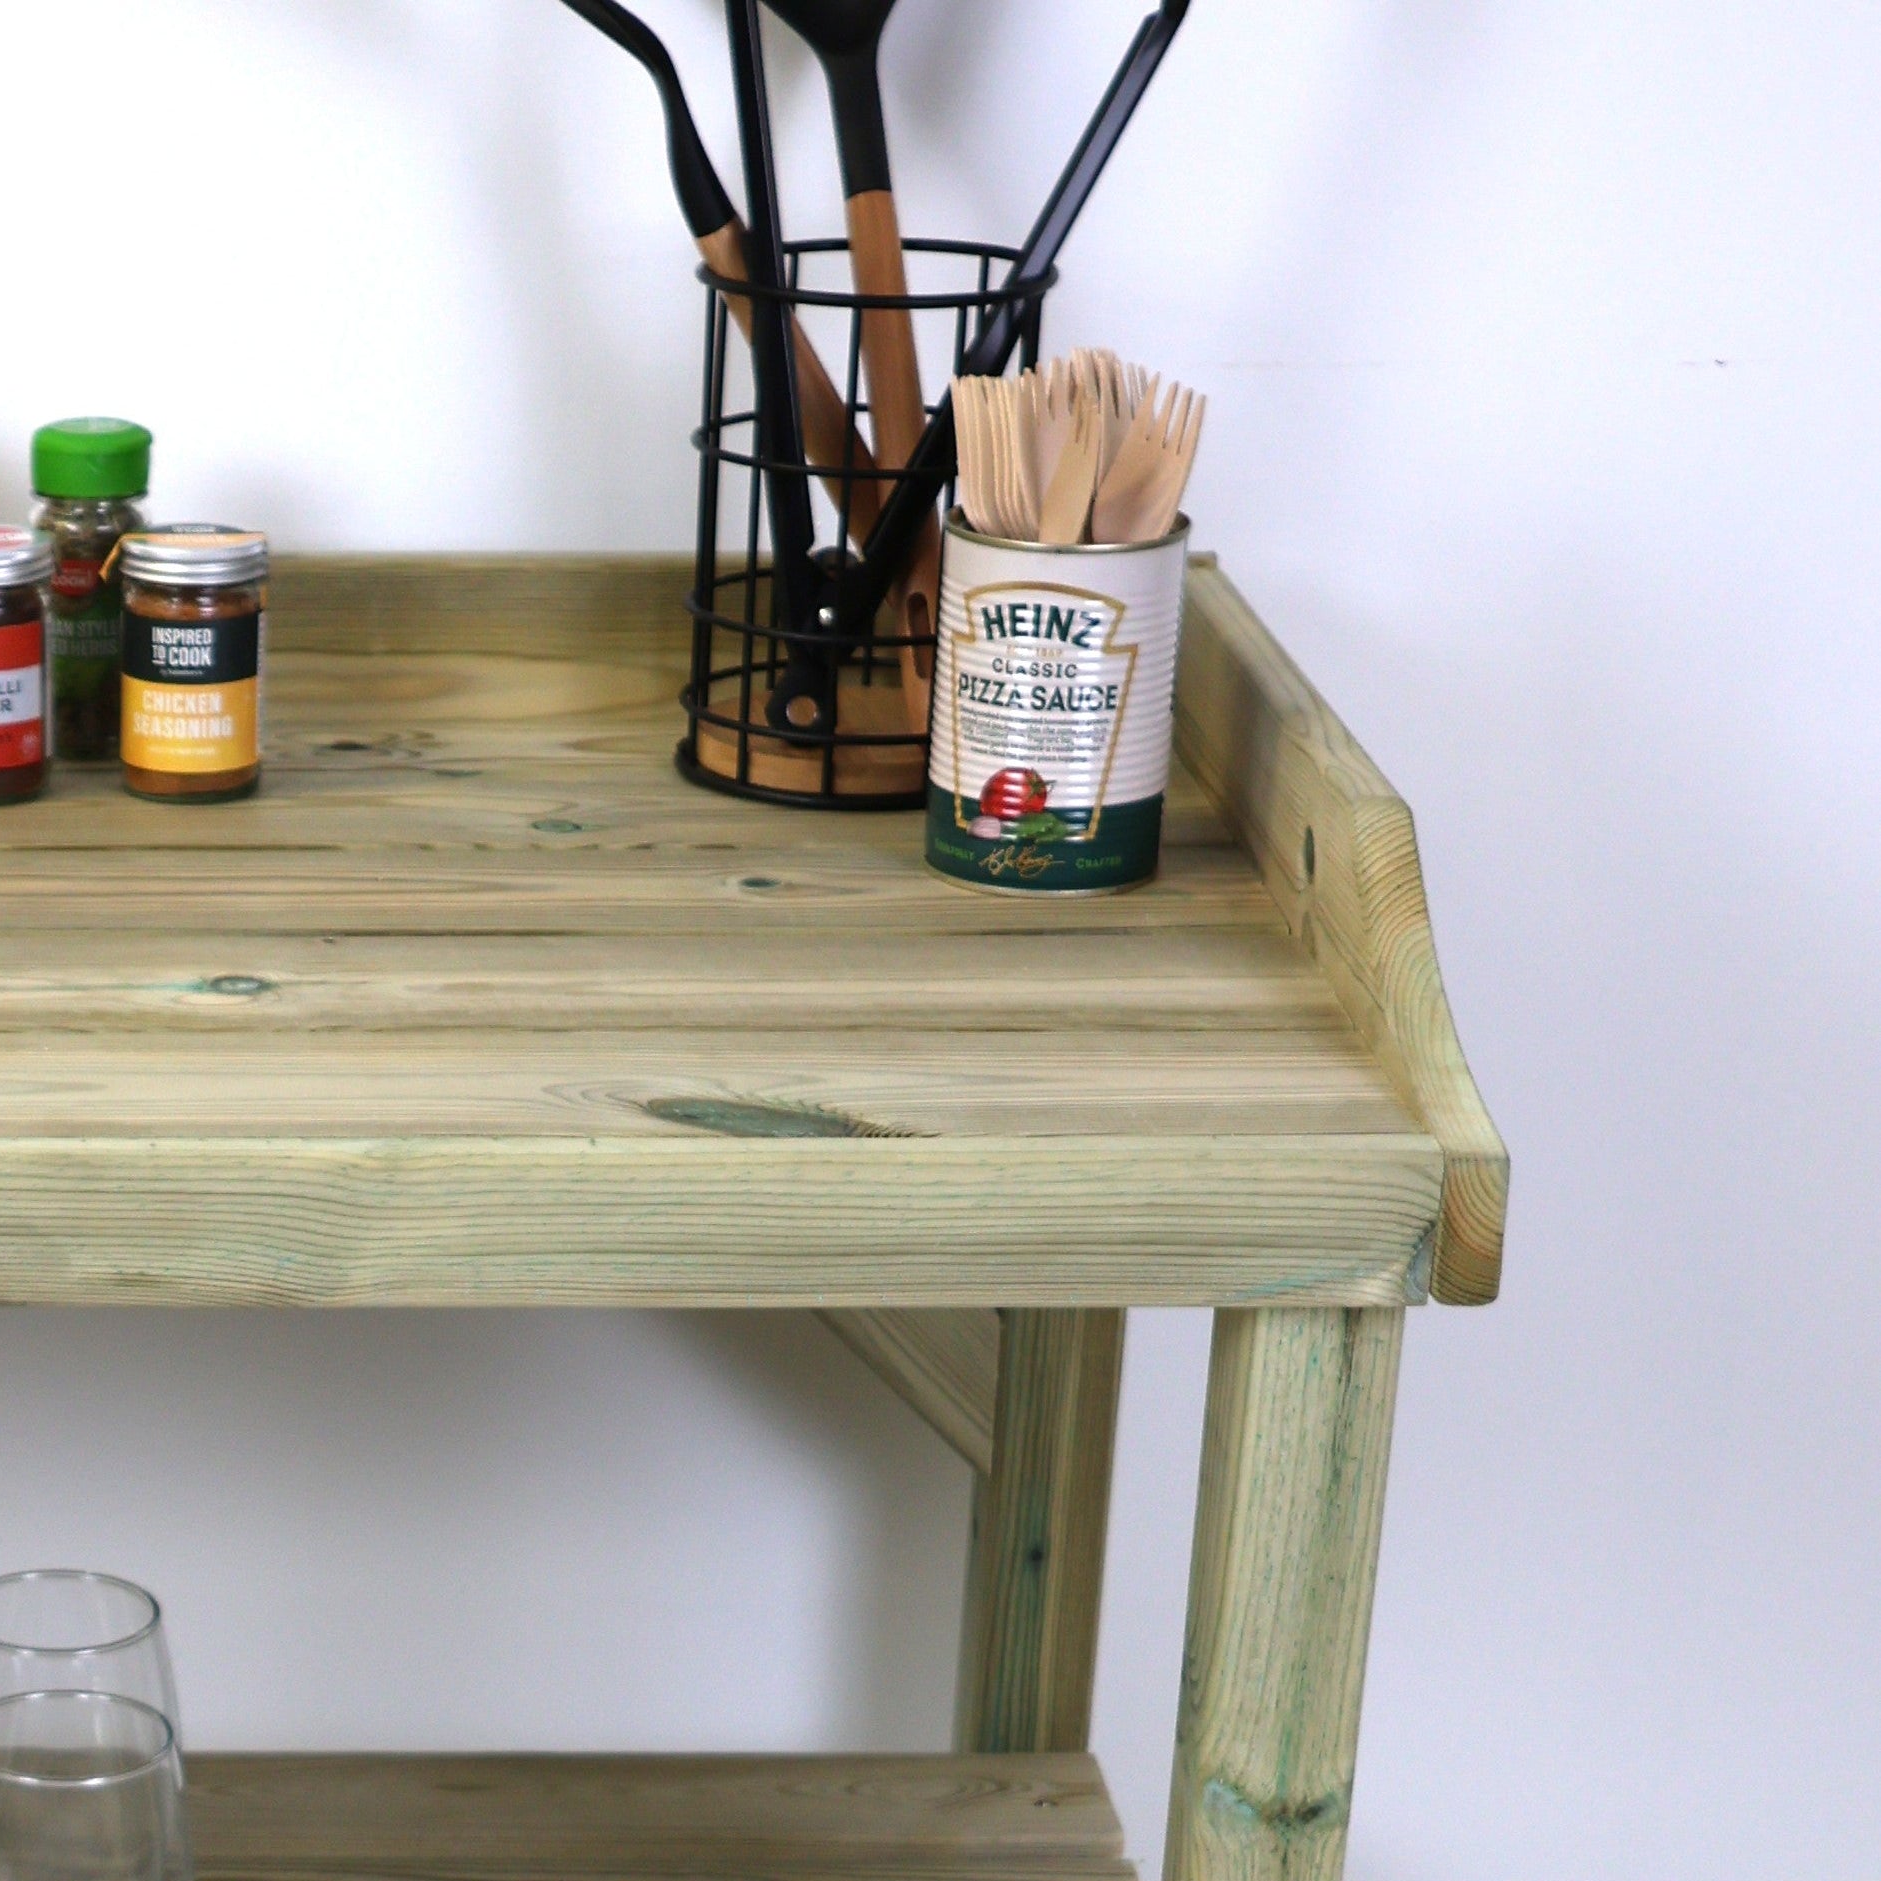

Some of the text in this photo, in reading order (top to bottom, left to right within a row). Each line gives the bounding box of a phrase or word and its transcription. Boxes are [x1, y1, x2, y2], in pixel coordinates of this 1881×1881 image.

[152, 627, 212, 645] INSPIRED
[981, 603, 1101, 648] HEINZ
[152, 646, 212, 666] TO COOK
[991, 658, 1078, 678] CLASSIC
[142, 691, 223, 714] CHICKEN
[958, 673, 1118, 711] PIZZA SAUCE
[132, 713, 234, 739] SEASONING
